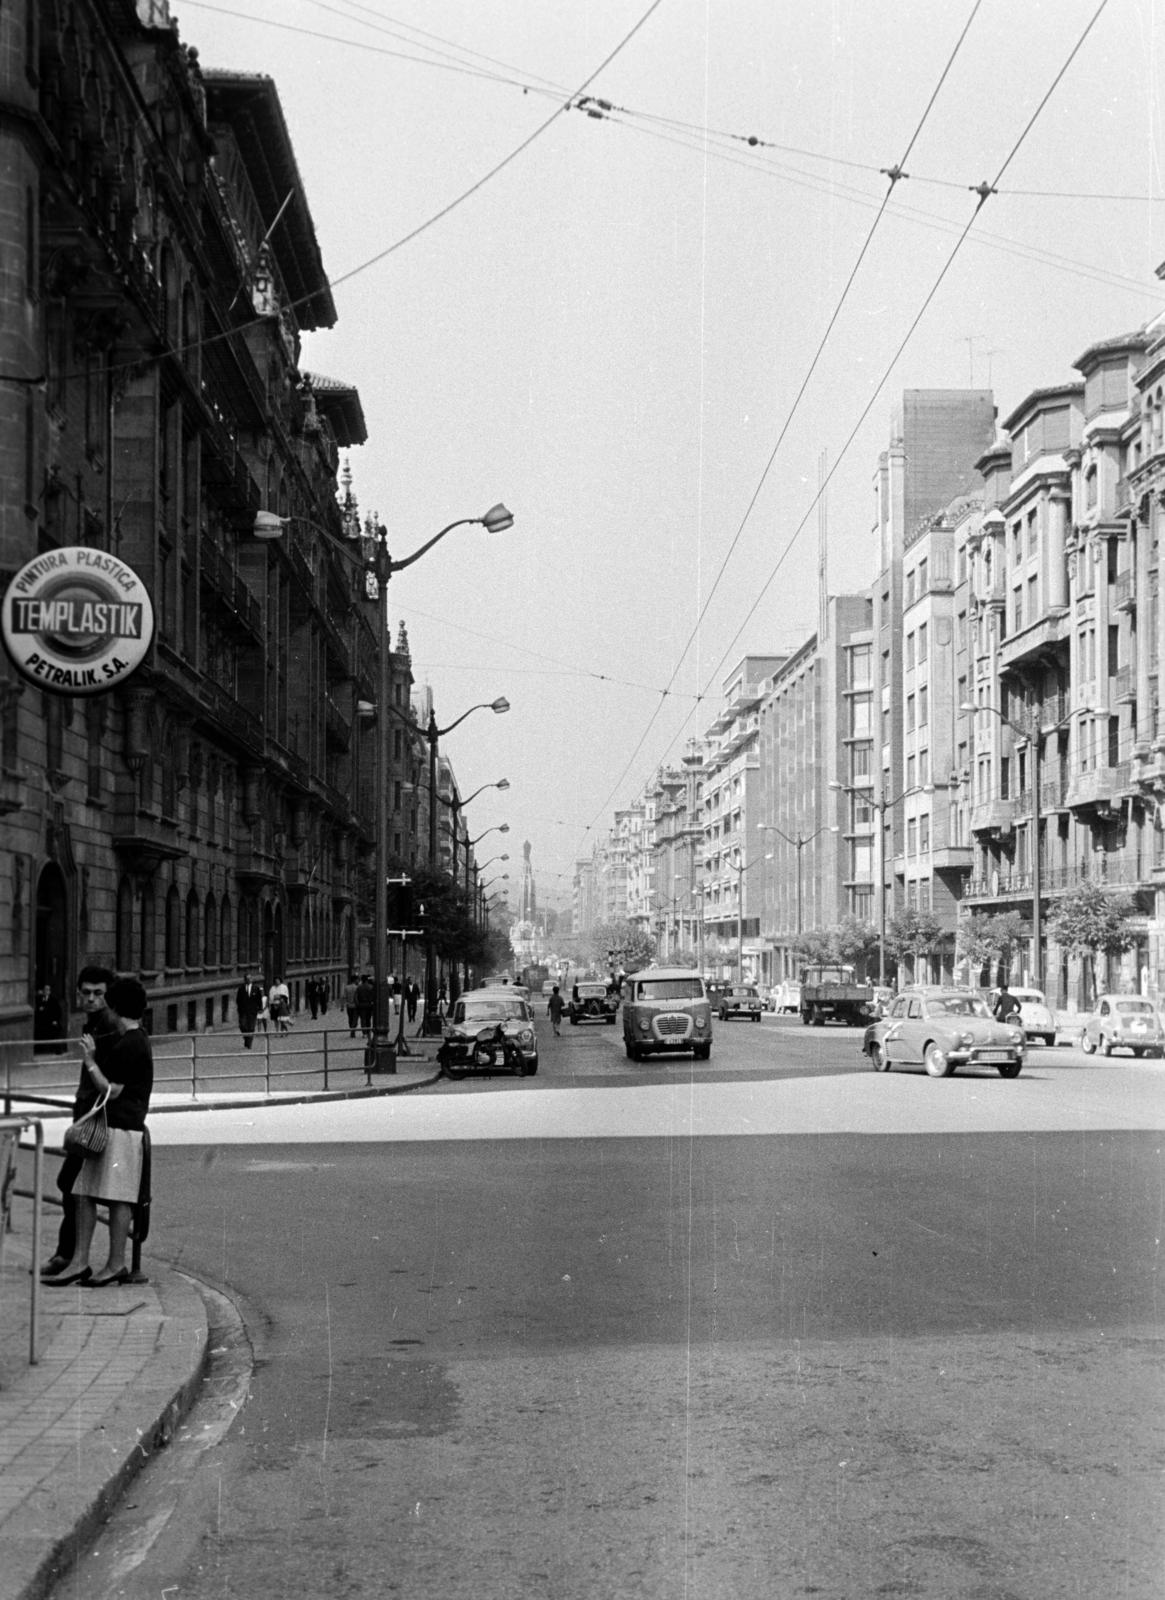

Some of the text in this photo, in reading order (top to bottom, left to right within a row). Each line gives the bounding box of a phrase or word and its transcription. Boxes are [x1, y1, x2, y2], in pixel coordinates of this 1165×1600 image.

[15, 551, 137, 593] PINTURA PLASTICA
[17, 600, 138, 636] TEMPLASTIK
